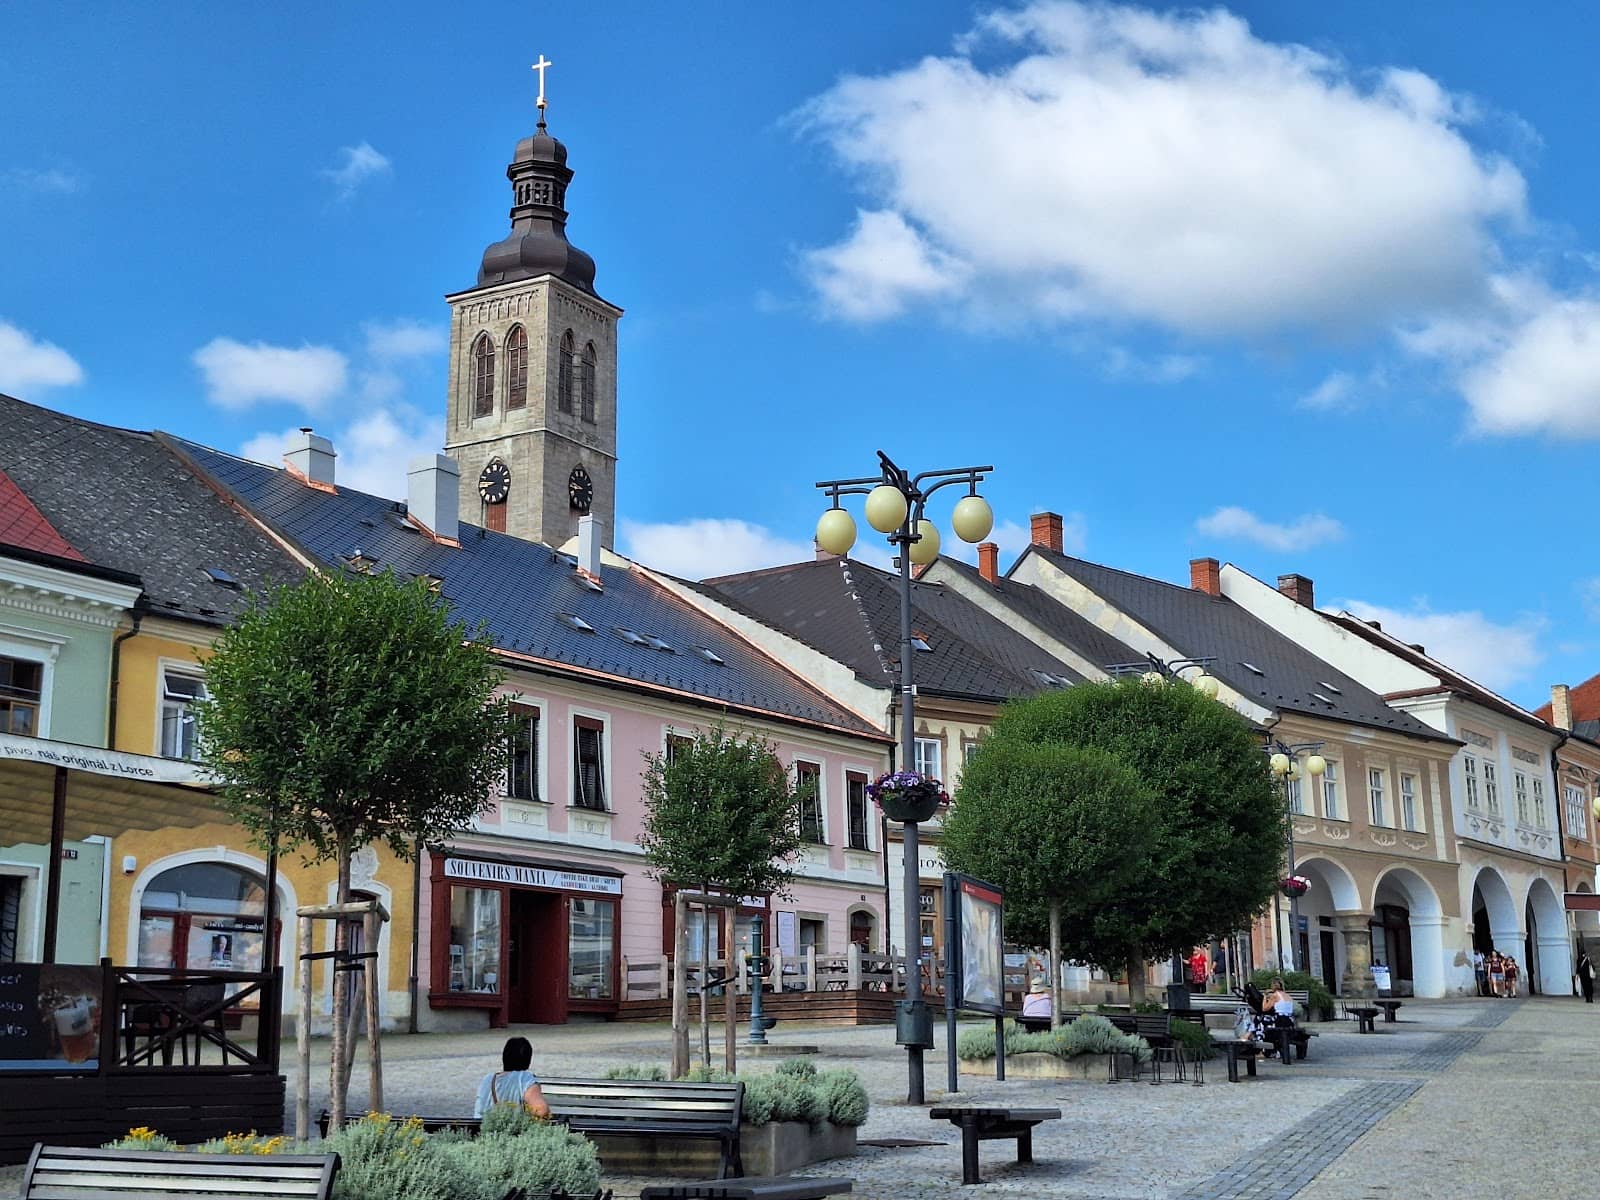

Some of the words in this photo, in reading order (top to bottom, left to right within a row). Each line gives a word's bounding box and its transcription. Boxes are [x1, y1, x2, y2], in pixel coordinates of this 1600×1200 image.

[110, 763, 117, 771] z
[450, 859, 511, 881] SOUVENIRS
[514, 867, 546, 885] MANIA
